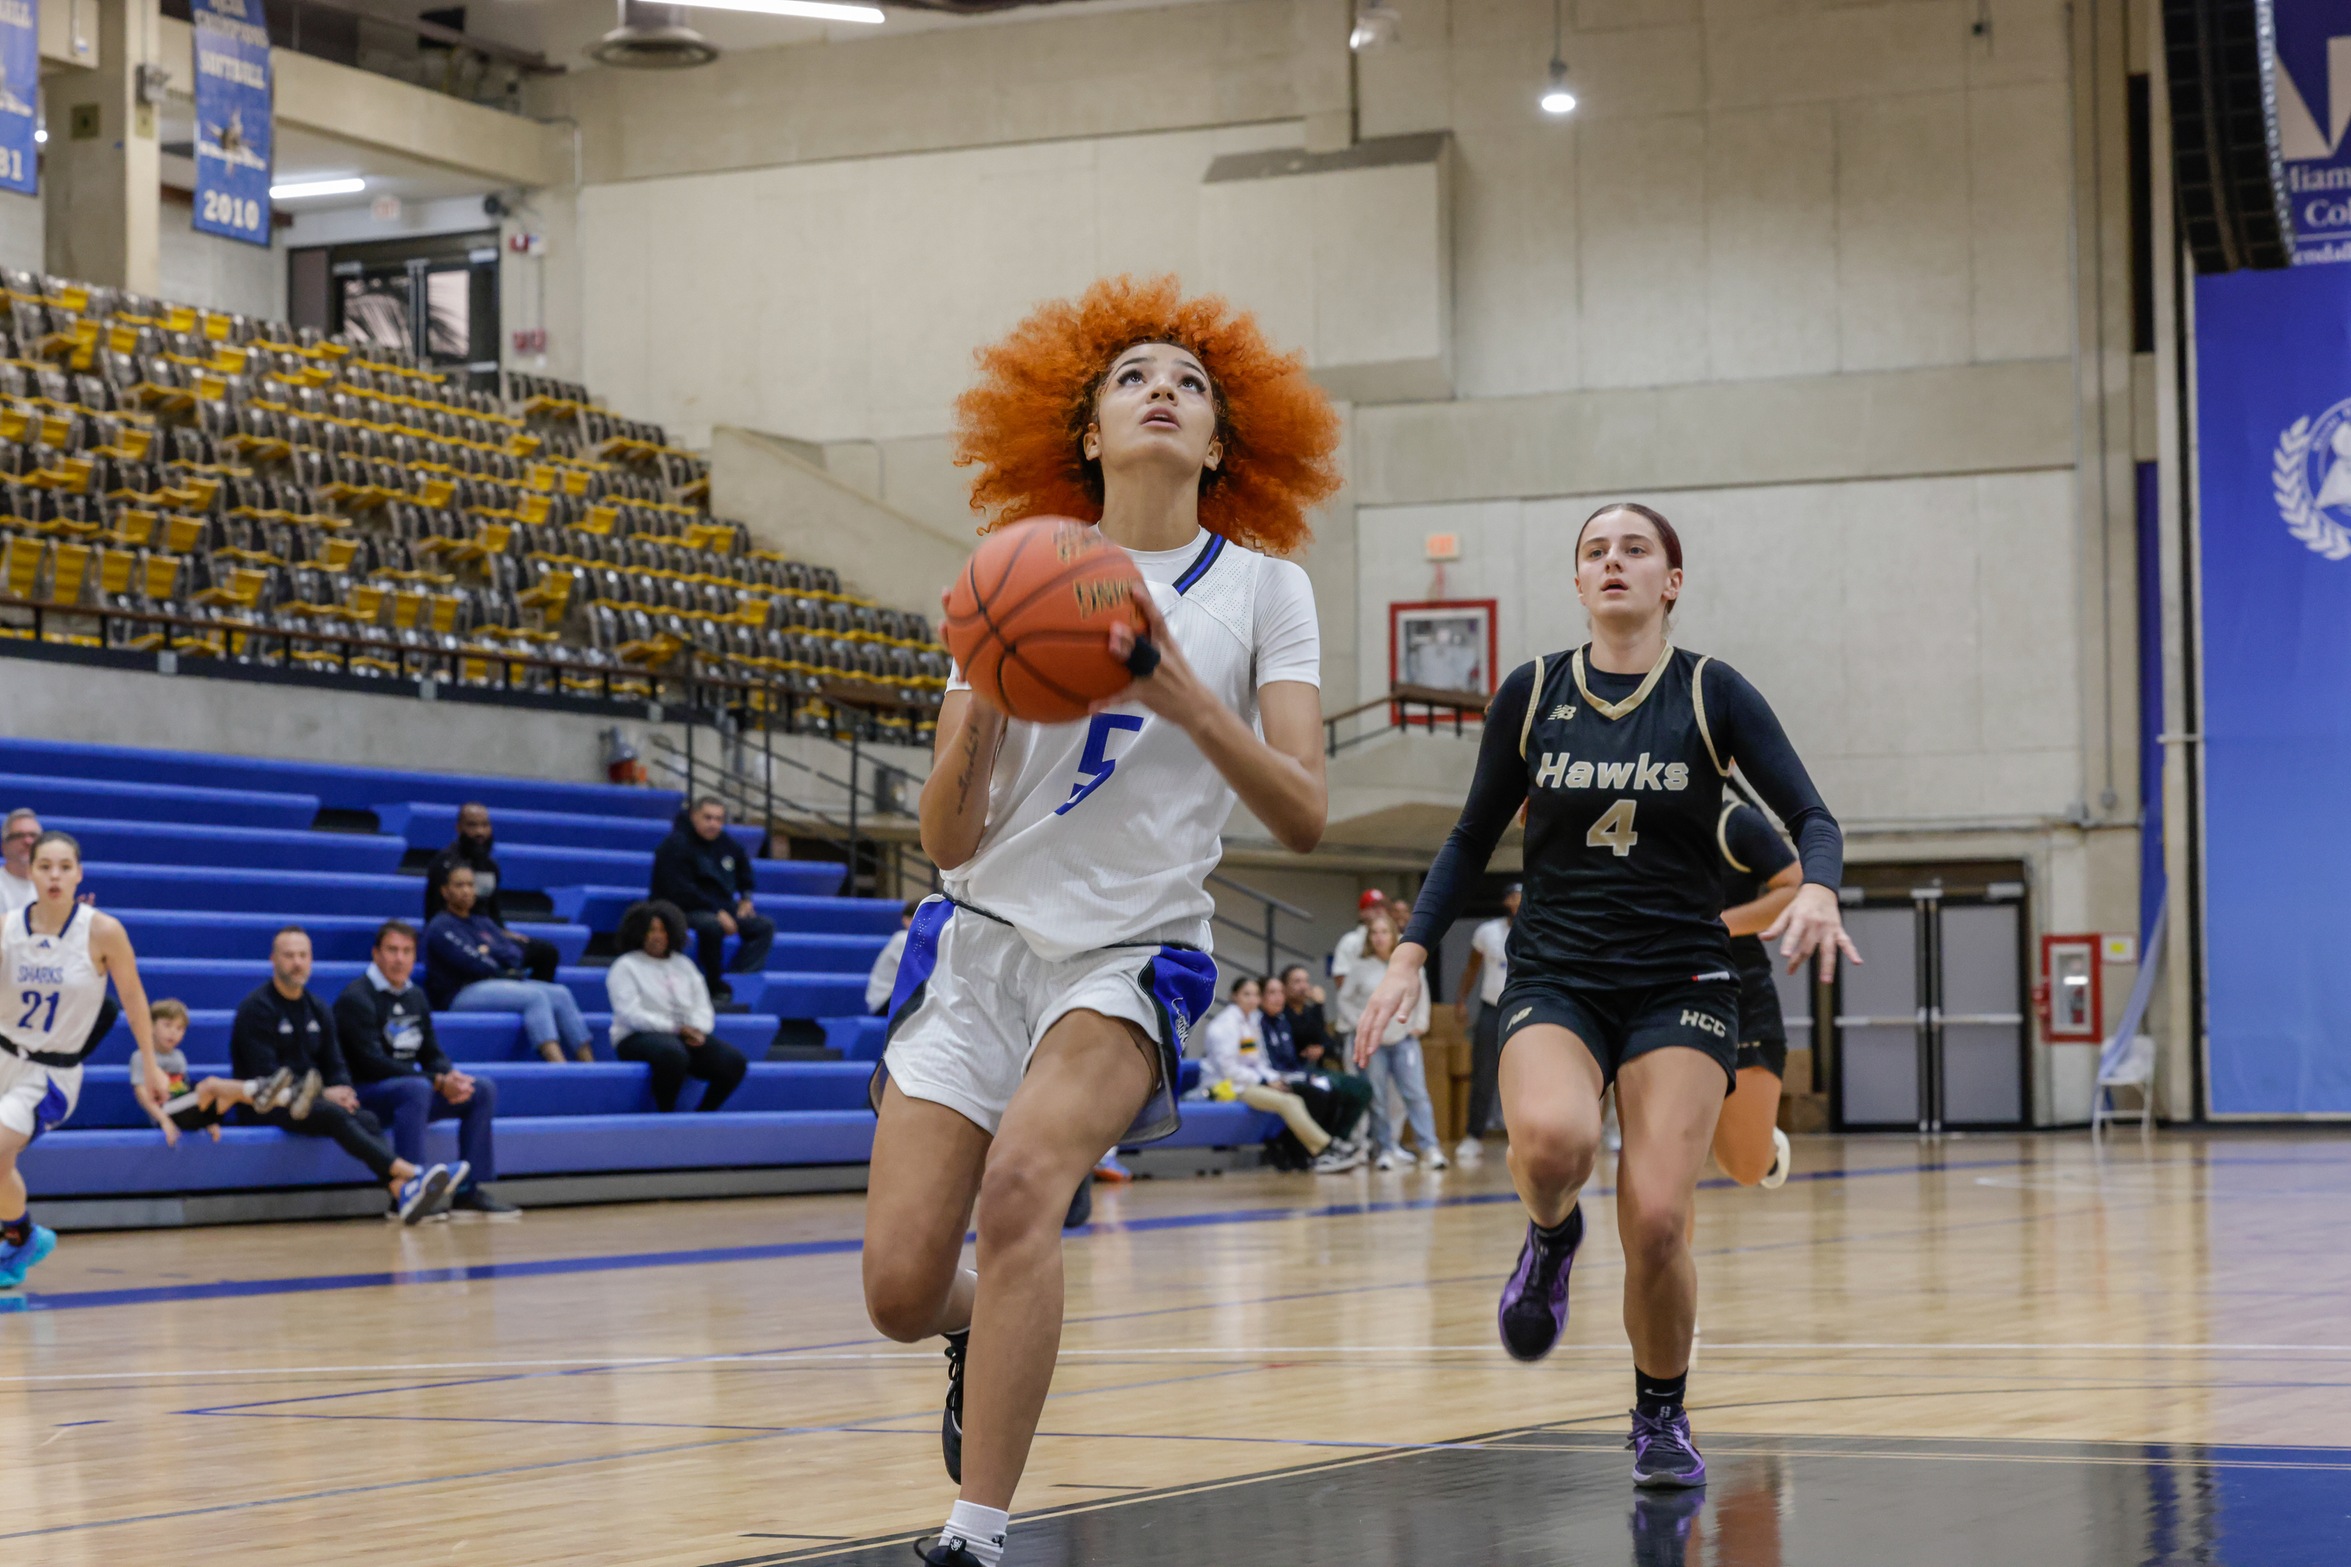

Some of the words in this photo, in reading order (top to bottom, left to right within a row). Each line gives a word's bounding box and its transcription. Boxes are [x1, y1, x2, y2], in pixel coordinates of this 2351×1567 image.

[203, 189, 260, 232] 2010
[1535, 752, 1689, 791] Hawks
[1586, 799, 1638, 857] 4
[17, 964, 64, 985] SHARKS
[17, 989, 60, 1033] 21
[1679, 1009, 1726, 1038] HCC
